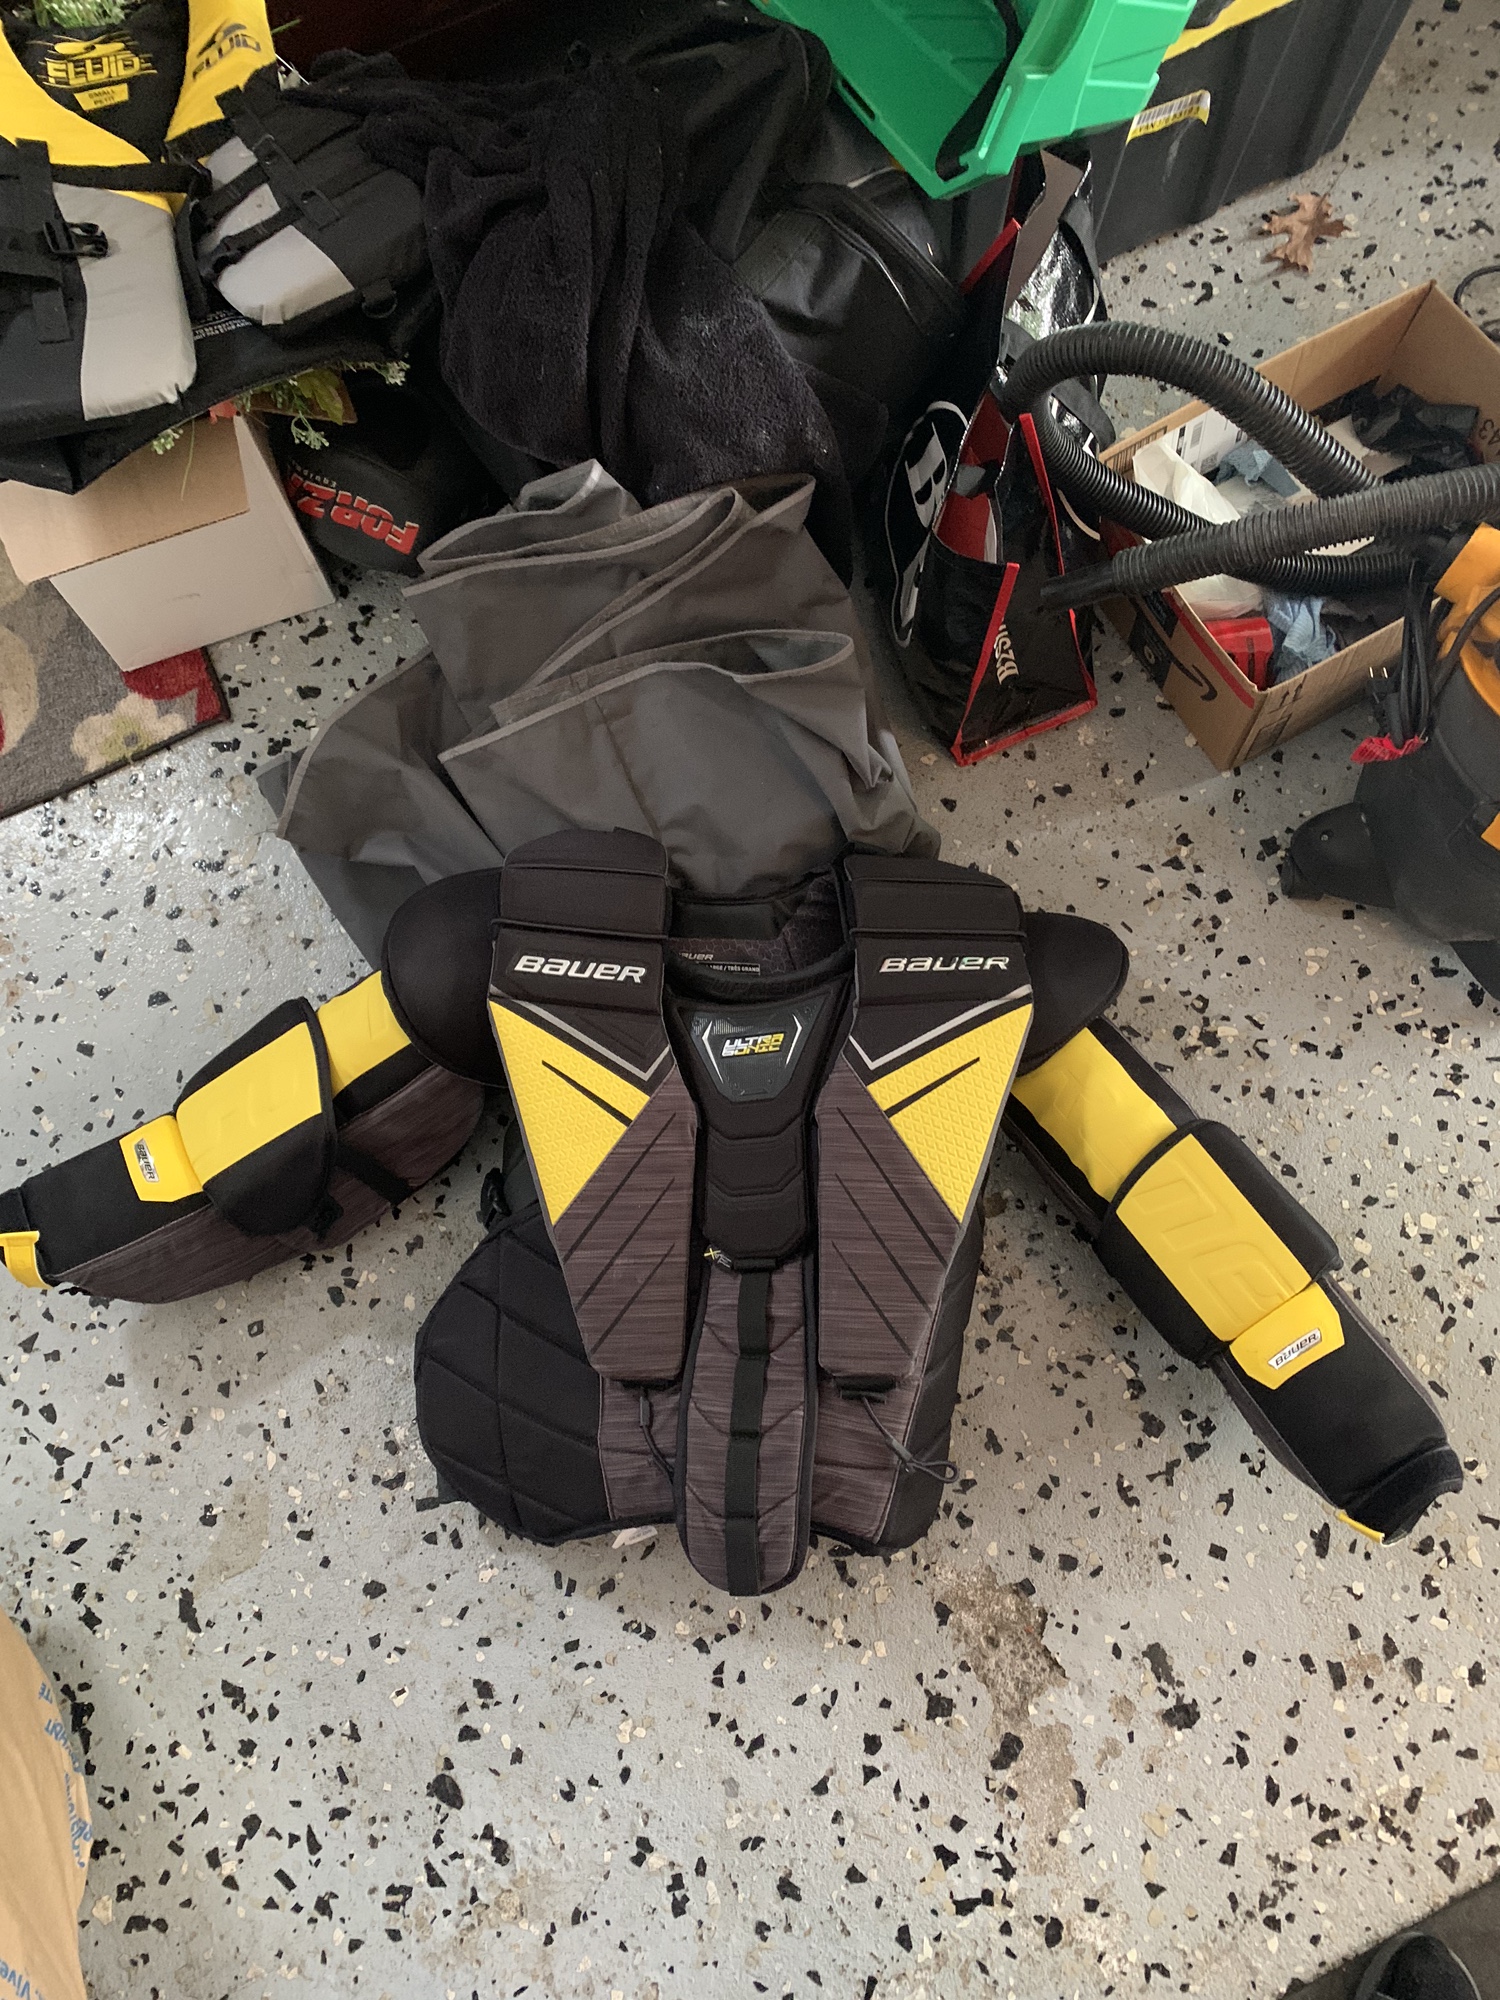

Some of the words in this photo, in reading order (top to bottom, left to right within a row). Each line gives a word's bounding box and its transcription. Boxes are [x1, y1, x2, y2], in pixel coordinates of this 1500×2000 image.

[46, 55, 140, 86] FLUID
[514, 955, 646, 984] BAUER
[679, 952, 714, 961] AUER
[879, 956, 1010, 973] BAUER
[137, 1143, 155, 1180] BAUER
[1275, 1333, 1318, 1366] BAUER
